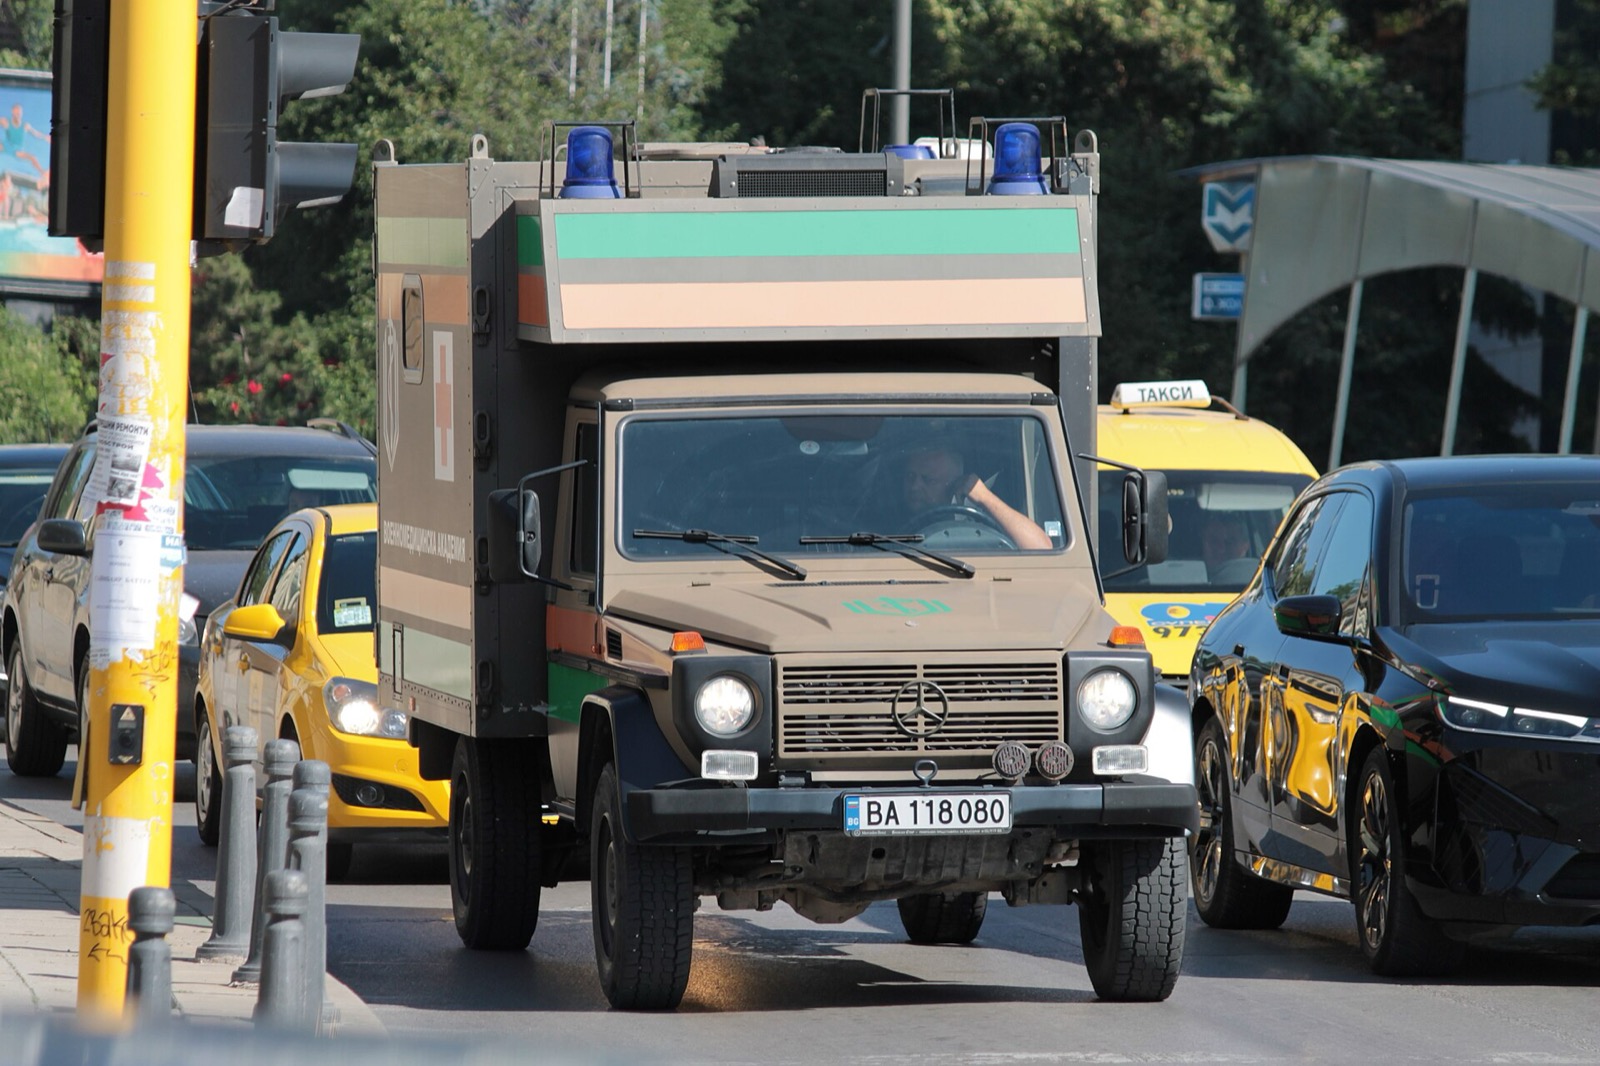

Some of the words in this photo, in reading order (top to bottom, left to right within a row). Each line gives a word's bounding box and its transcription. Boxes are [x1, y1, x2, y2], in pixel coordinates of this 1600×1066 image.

[1138, 386, 1193, 403] ТАКСИ
[437, 532, 466, 565] АКАДЕМИЯ
[847, 818, 859, 826] BG
[866, 800, 900, 826] BA
